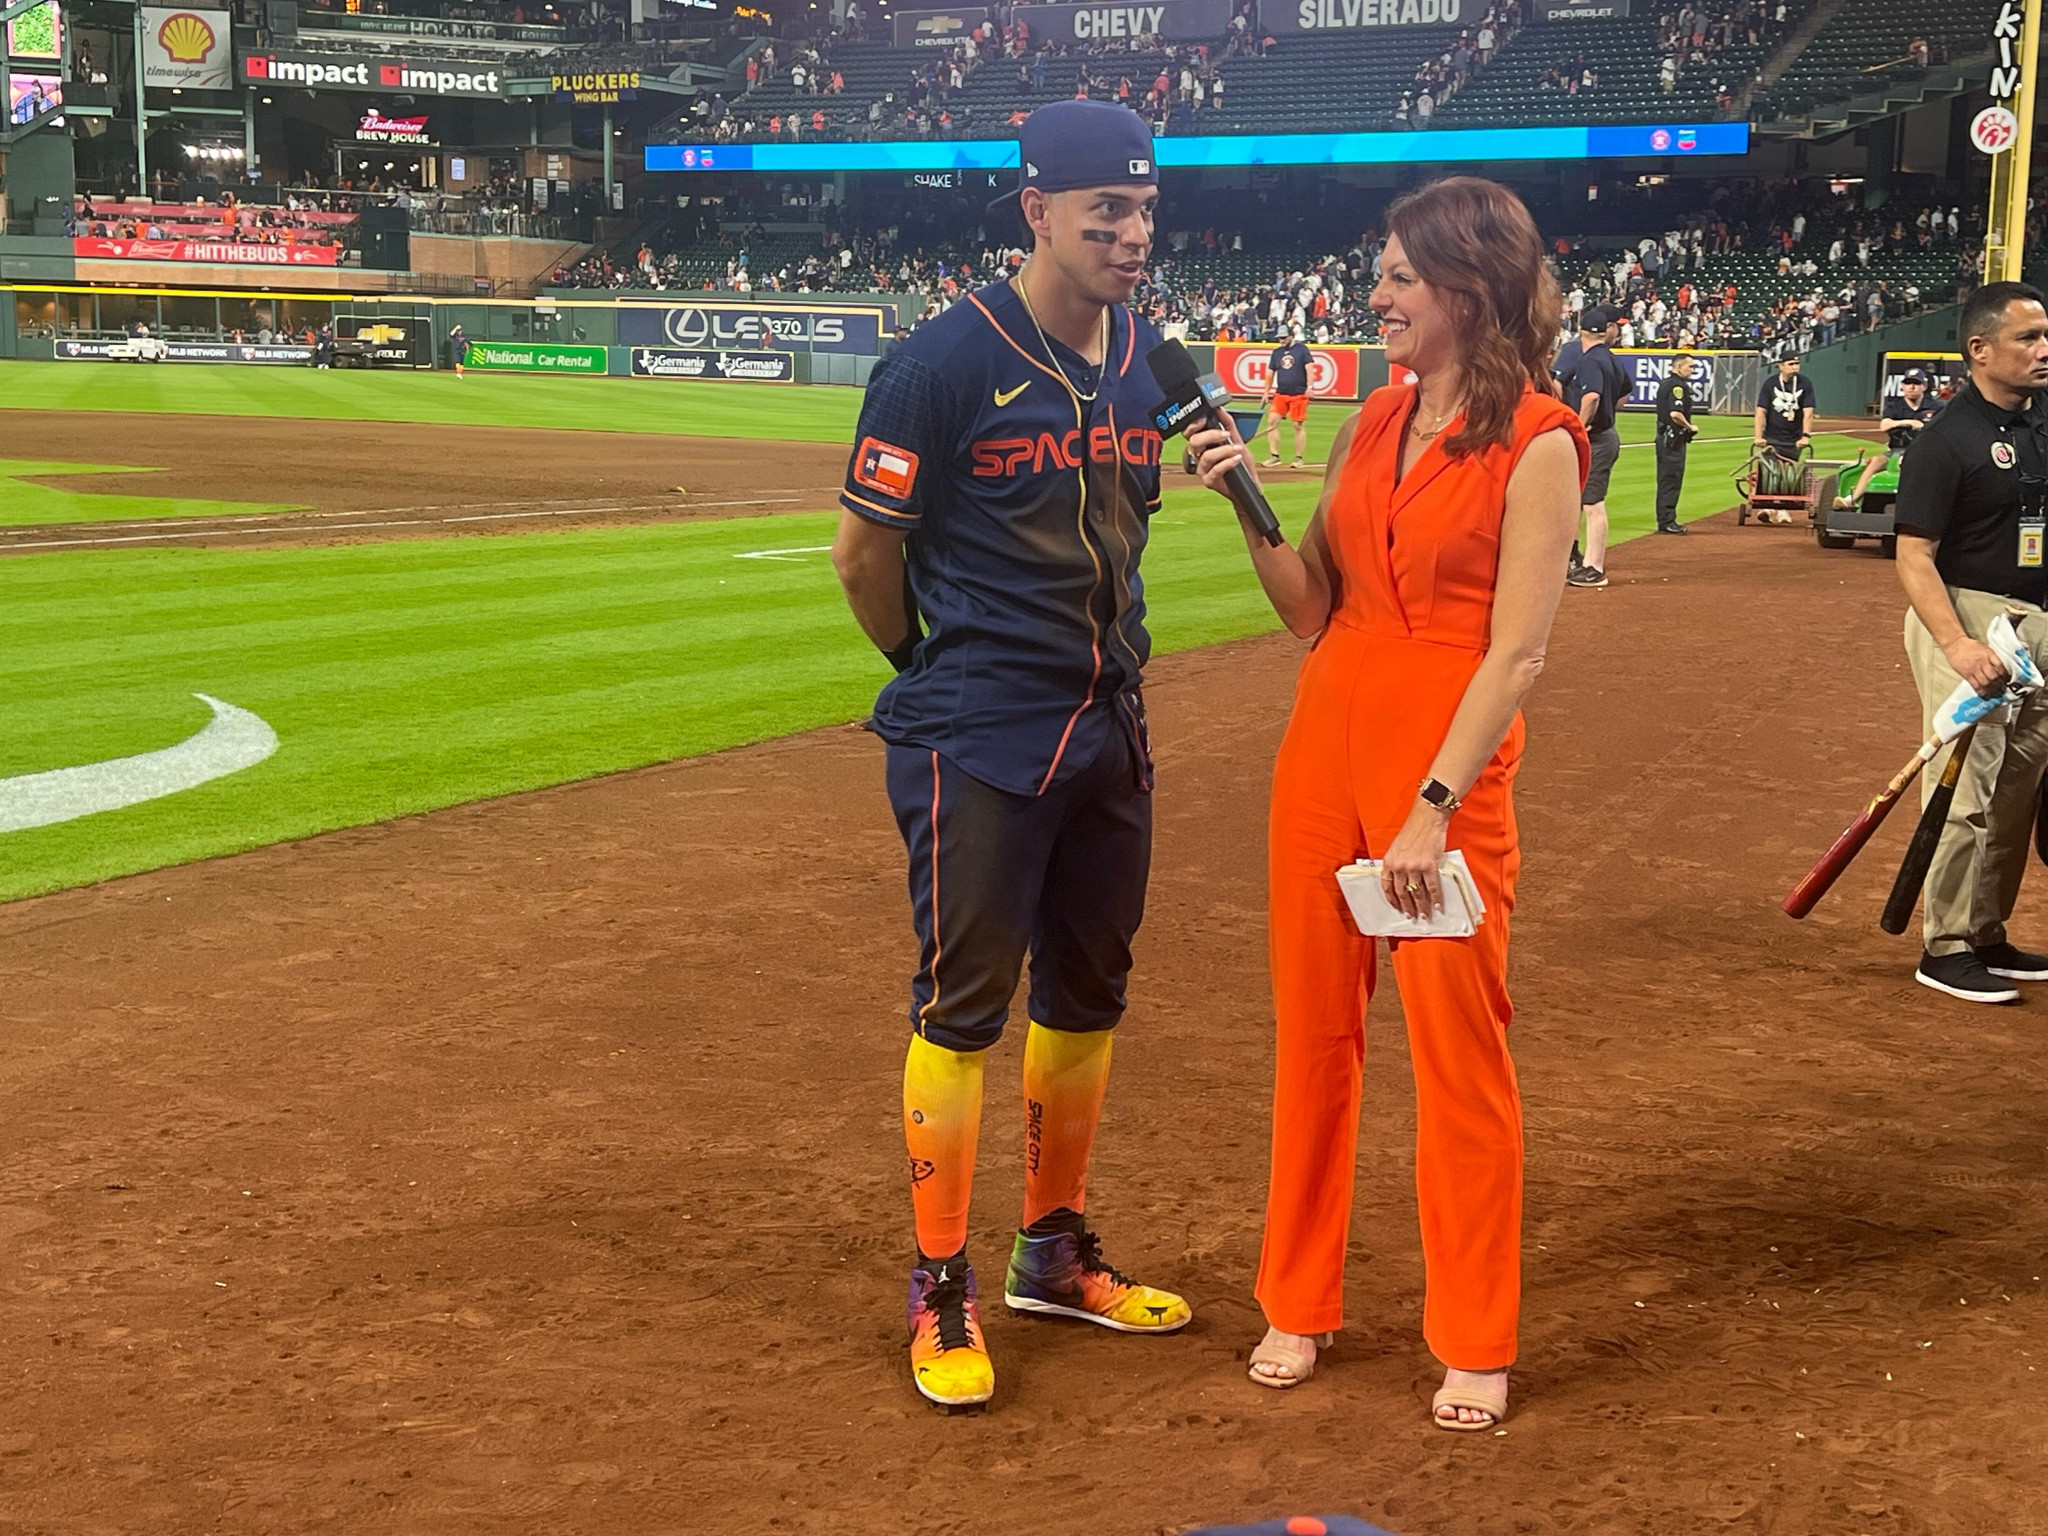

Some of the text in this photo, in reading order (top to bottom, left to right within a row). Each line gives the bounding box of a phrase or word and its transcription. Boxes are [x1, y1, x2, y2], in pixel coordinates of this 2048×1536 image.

[1074, 7, 1164, 38] CHEVY
[1299, 0, 1460, 29] SILVERADO
[1548, 8, 1613, 19] CHEVROLET
[1990, 0, 2021, 97] KIN
[146, 66, 201, 78] timewise
[268, 54, 368, 86] impact
[401, 62, 498, 93] impact
[552, 73, 640, 91] PLUCKERS
[574, 91, 618, 102] WING BAR
[360, 116, 423, 131] Budweiser
[356, 130, 429, 144] BREW HOUSE
[184, 244, 288, 262] #HITTHEBUDS
[772, 319, 801, 335] 370
[538, 354, 556, 366] Car
[557, 355, 592, 367] Rental
[658, 354, 705, 368] Germania
[735, 357, 784, 371] Germania
[1636, 357, 1712, 380] ENEGY
[972, 426, 1162, 476] SPACE CIT
[1028, 1098, 1042, 1177] SPACE CITY
